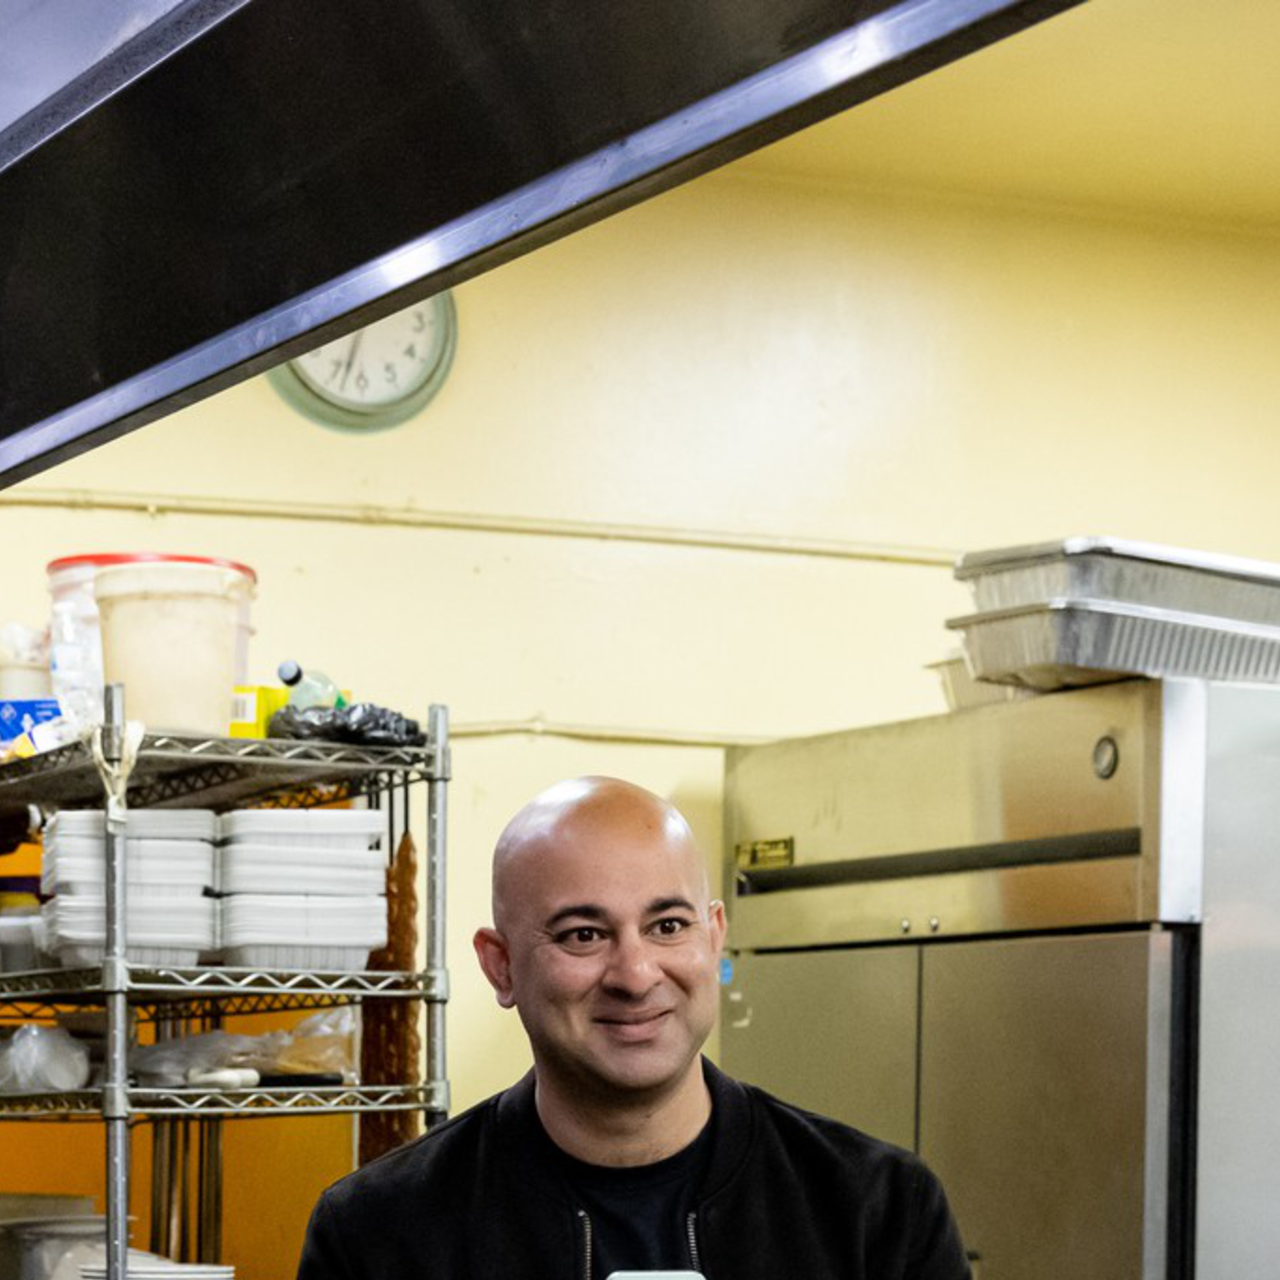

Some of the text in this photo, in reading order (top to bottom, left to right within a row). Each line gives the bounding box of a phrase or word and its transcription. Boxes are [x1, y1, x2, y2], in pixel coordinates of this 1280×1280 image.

[413, 311, 426, 333] 3
[403, 343, 416, 360] 4
[354, 370, 369, 391] 6
[384, 362, 397, 384] 5
